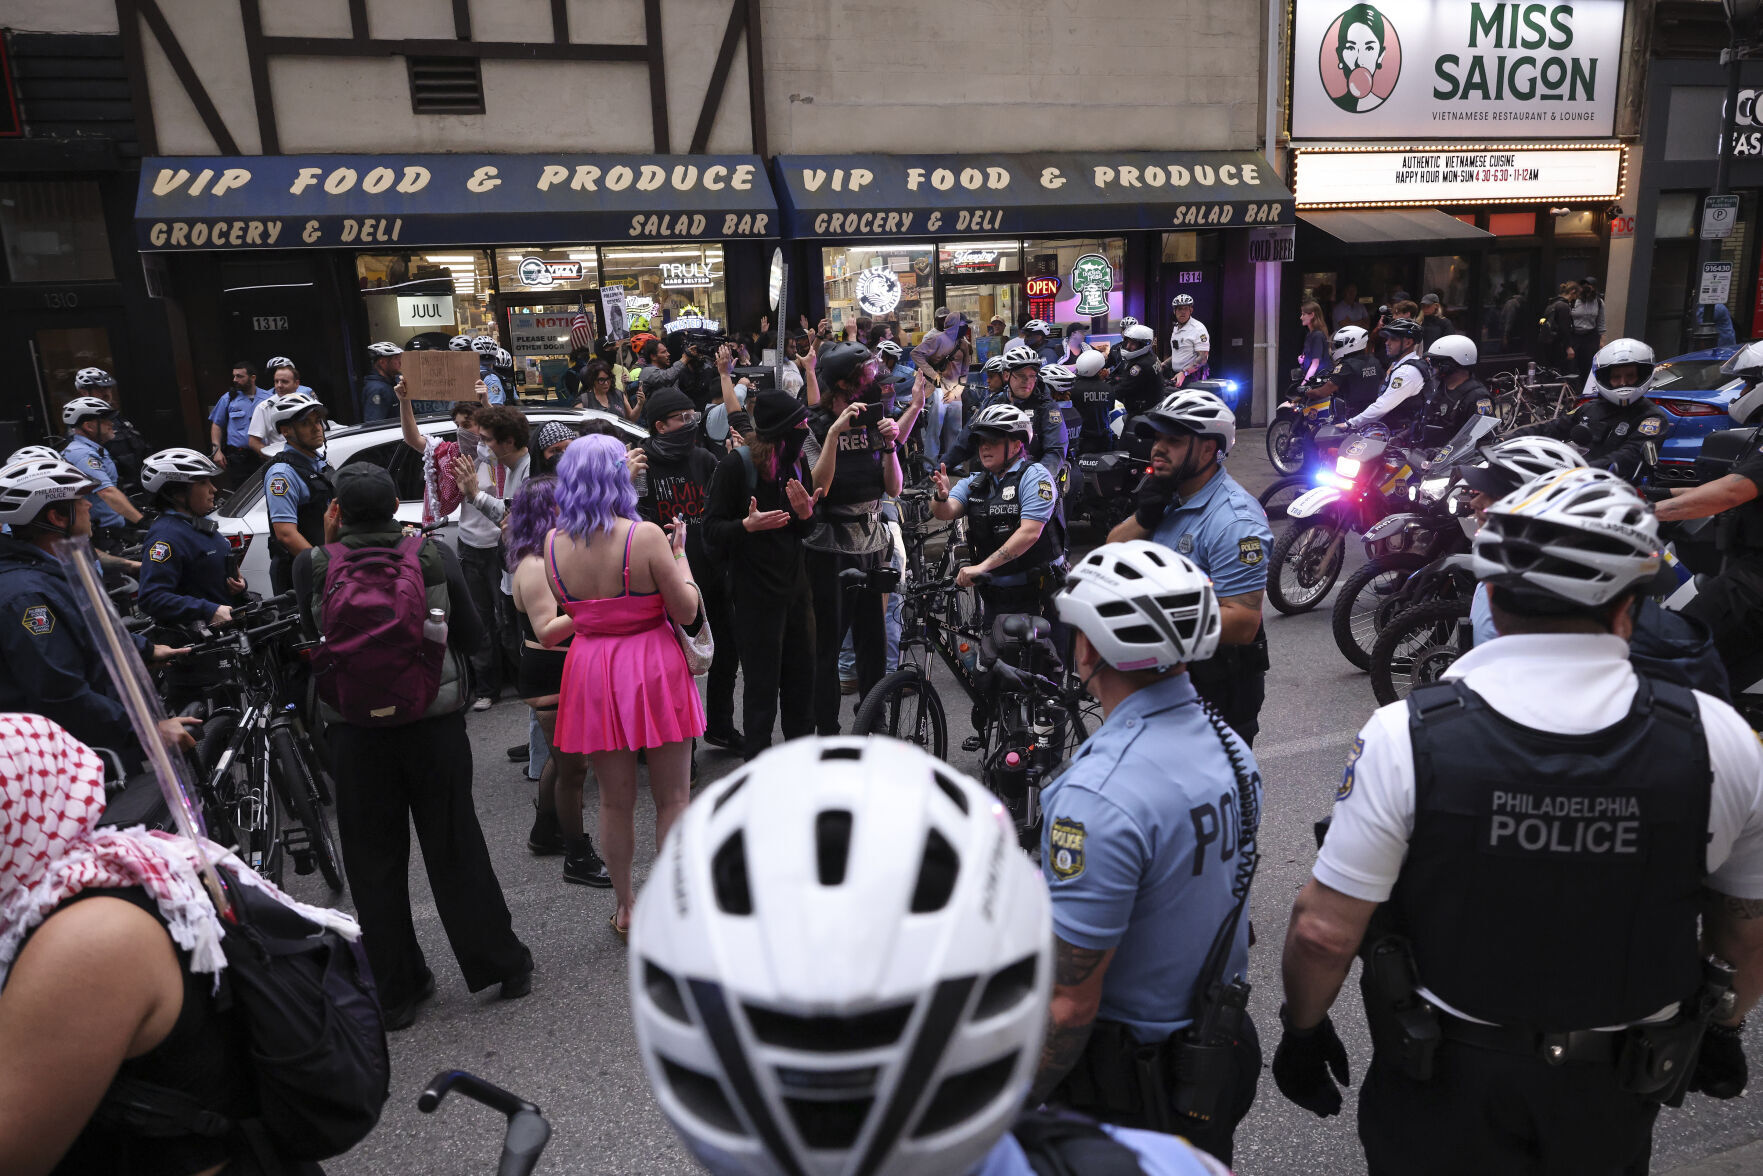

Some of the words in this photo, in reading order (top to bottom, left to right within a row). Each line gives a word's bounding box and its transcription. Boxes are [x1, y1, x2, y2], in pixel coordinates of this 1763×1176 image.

[1468, 2, 1574, 51] MISS
[1433, 54, 1599, 101] SAIGON
[1432, 111, 1489, 121] VIETNAMESE
[1492, 111, 1548, 121] RESTAURANT
[1550, 111, 1557, 121] &
[1559, 111, 1595, 121] LOUNGE
[1402, 155, 1441, 169] AUTHENTIC
[1445, 154, 1487, 169] VIETNAMESE
[1489, 154, 1516, 168] CUISINE
[152, 168, 252, 197] VIP
[289, 166, 432, 195] FOOD
[467, 165, 502, 193] &
[536, 164, 756, 192] PRODUCE
[802, 168, 874, 192] VIP
[906, 166, 1011, 191] FOOD
[1040, 167, 1067, 189] &
[1093, 164, 1261, 188] PRODUCE
[1395, 170, 1419, 184] HAPPY
[1420, 170, 1440, 184] HOUR
[1442, 169, 1475, 183] MON-SUN
[814, 211, 914, 234] GROCERY
[927, 211, 943, 231] &
[955, 209, 1003, 232] DELI
[1173, 204, 1234, 225] SALAD
[1244, 203, 1282, 223] BAR
[150, 220, 282, 247] GROCERY
[302, 219, 322, 244] &
[340, 218, 403, 243] DELI
[628, 214, 707, 237] SALAD
[721, 212, 769, 236] BAR
[1611, 217, 1635, 233] FDC
[1249, 239, 1271, 261] COLD
[1273, 238, 1294, 260] BEER
[546, 264, 580, 277] VIZZY
[659, 262, 713, 278] TRULY
[1705, 265, 1731, 273] 916430
[1027, 280, 1057, 295] OPEN
[412, 303, 442, 319] JUUL
[254, 316, 288, 331] 1312
[664, 318, 702, 335] TWISTED
[701, 319, 720, 332] TEA
[516, 335, 545, 343] PLEASE
[1363, 368, 1377, 378] POLICE
[1083, 391, 1110, 402] POLICE
[836, 434, 869, 451] RES
[669, 476, 686, 484] The
[34, 486, 76, 497] PHILADELPHIA
[45, 491, 67, 501] POLICE
[672, 480, 705, 503] Mix
[658, 500, 704, 521] Roo
[989, 507, 1019, 515] POLICE
[1241, 543, 1261, 552] POLICE
[1492, 790, 1641, 818] PHILADELPHIA
[1052, 830, 1083, 850] POLICE
[1489, 814, 1641, 854] POLICE
